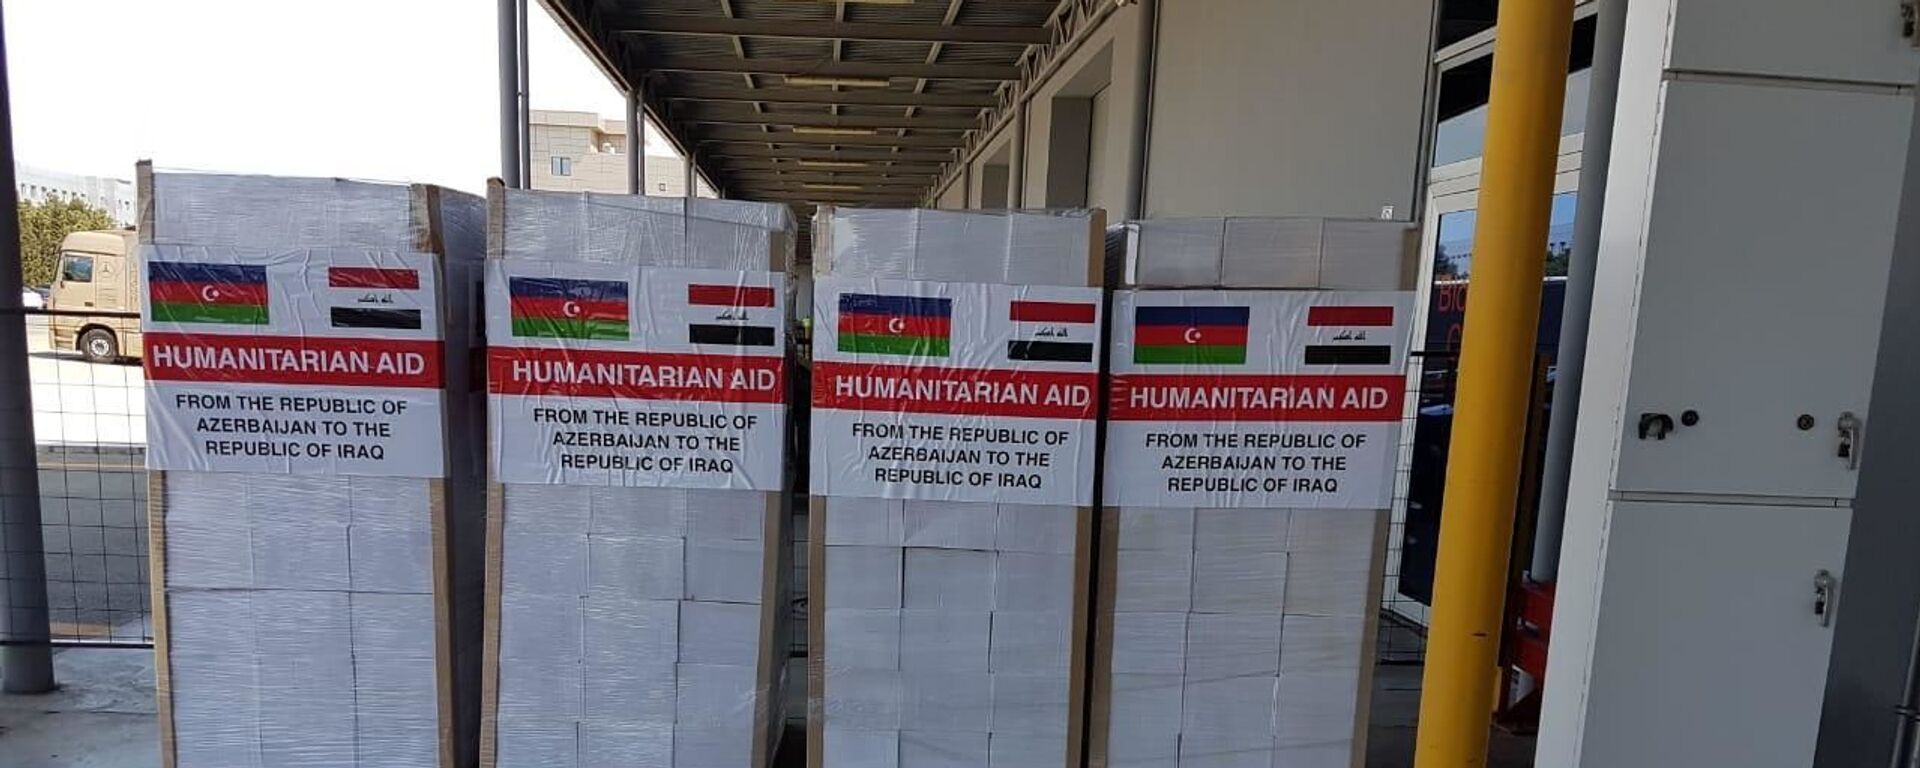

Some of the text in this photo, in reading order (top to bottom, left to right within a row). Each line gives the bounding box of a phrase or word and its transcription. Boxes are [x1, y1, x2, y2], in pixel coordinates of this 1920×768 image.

[154, 344, 425, 375] HUMANITARIAN AID
[513, 360, 776, 391] HUMANITARIAN AID
[836, 374, 1090, 407] HUMANITARIAN AID
[1130, 386, 1388, 409] HUMANITARIAN AID
[176, 394, 407, 415] FROM THE REPUBLIC OF
[197, 418, 390, 437] AZERBAIJAN TO THE
[534, 409, 757, 430] FROM THE REPUBLIC OF
[553, 432, 740, 451] AZERBAIJAN TO THE
[853, 423, 1069, 445] FROM THE REPUBLIC OF
[1146, 433, 1366, 448] FROM THE REPUBLIC OF
[206, 441, 384, 460] REPUBLIC OF IRAQ
[868, 447, 1050, 467] AZERBAIJAN TO THE
[562, 454, 733, 474] REPUBLIC OF IRAQ
[1162, 456, 1346, 471] AZERBAIJAN TO THE
[875, 468, 1042, 489] REPUBLIC OF IRAQ
[1168, 478, 1338, 494] REPUBLIC OF IRAQ
